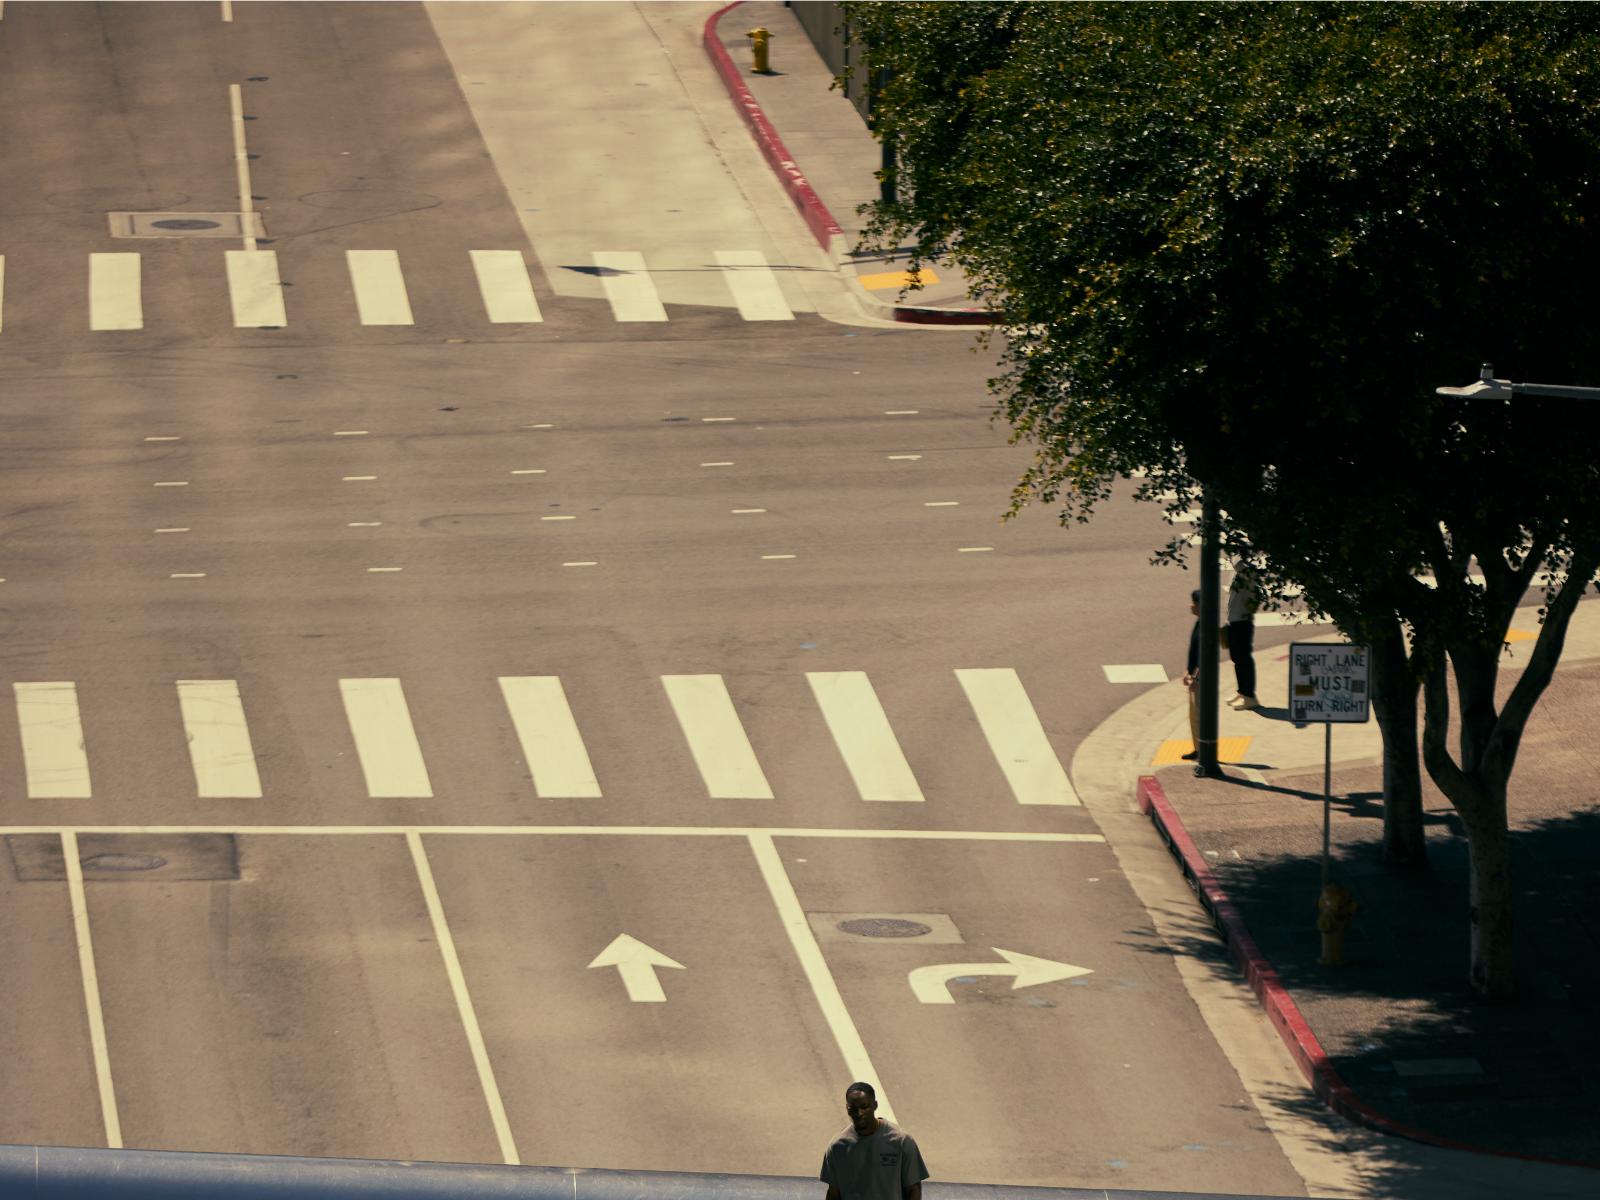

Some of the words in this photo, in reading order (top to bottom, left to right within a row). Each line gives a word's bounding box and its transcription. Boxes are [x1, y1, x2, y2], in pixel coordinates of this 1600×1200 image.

[1296, 654, 1327, 666] RIGHT
[1336, 655, 1366, 667] LANE
[1309, 676, 1352, 690] MUST
[1294, 700, 1324, 712] TURN
[1332, 700, 1365, 712] RIGHT
